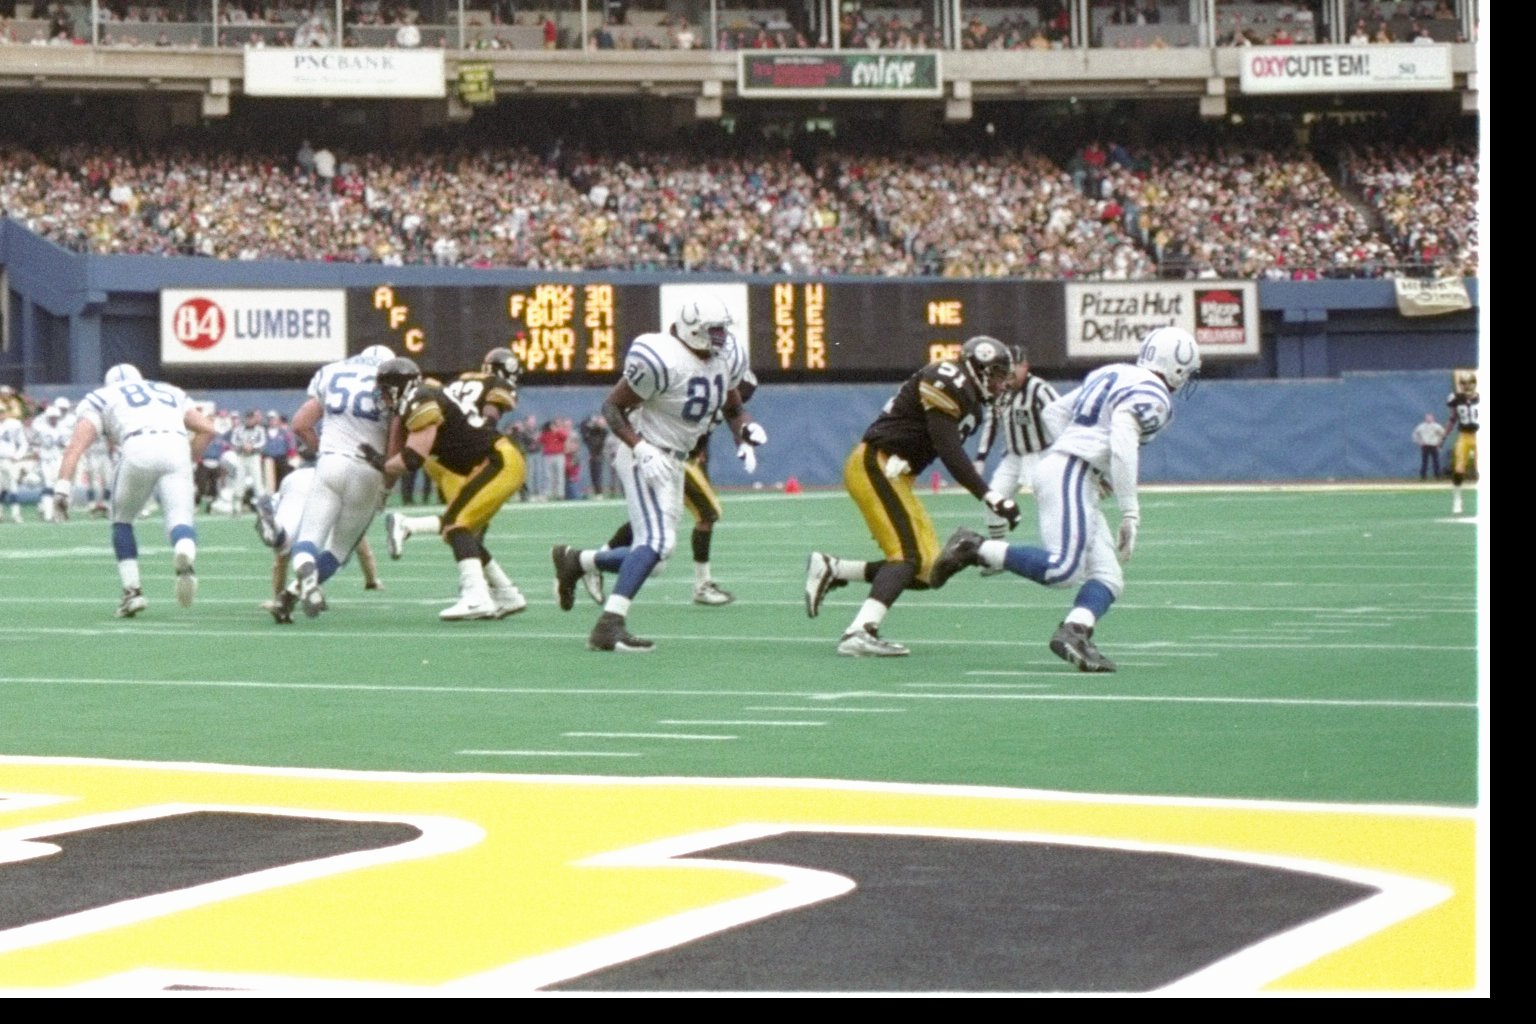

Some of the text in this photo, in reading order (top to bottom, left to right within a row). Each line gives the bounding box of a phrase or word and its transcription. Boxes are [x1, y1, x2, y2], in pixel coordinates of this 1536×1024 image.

[1251, 56, 1331, 78] OXYCUTE
[928, 301, 963, 325] NE
[1081, 292, 1183, 315] Pizza Hut
[177, 305, 331, 342] 84 LUMBER
[527, 348, 575, 371] PIT
[326, 372, 380, 422] 52
[681, 374, 724, 422] 81
